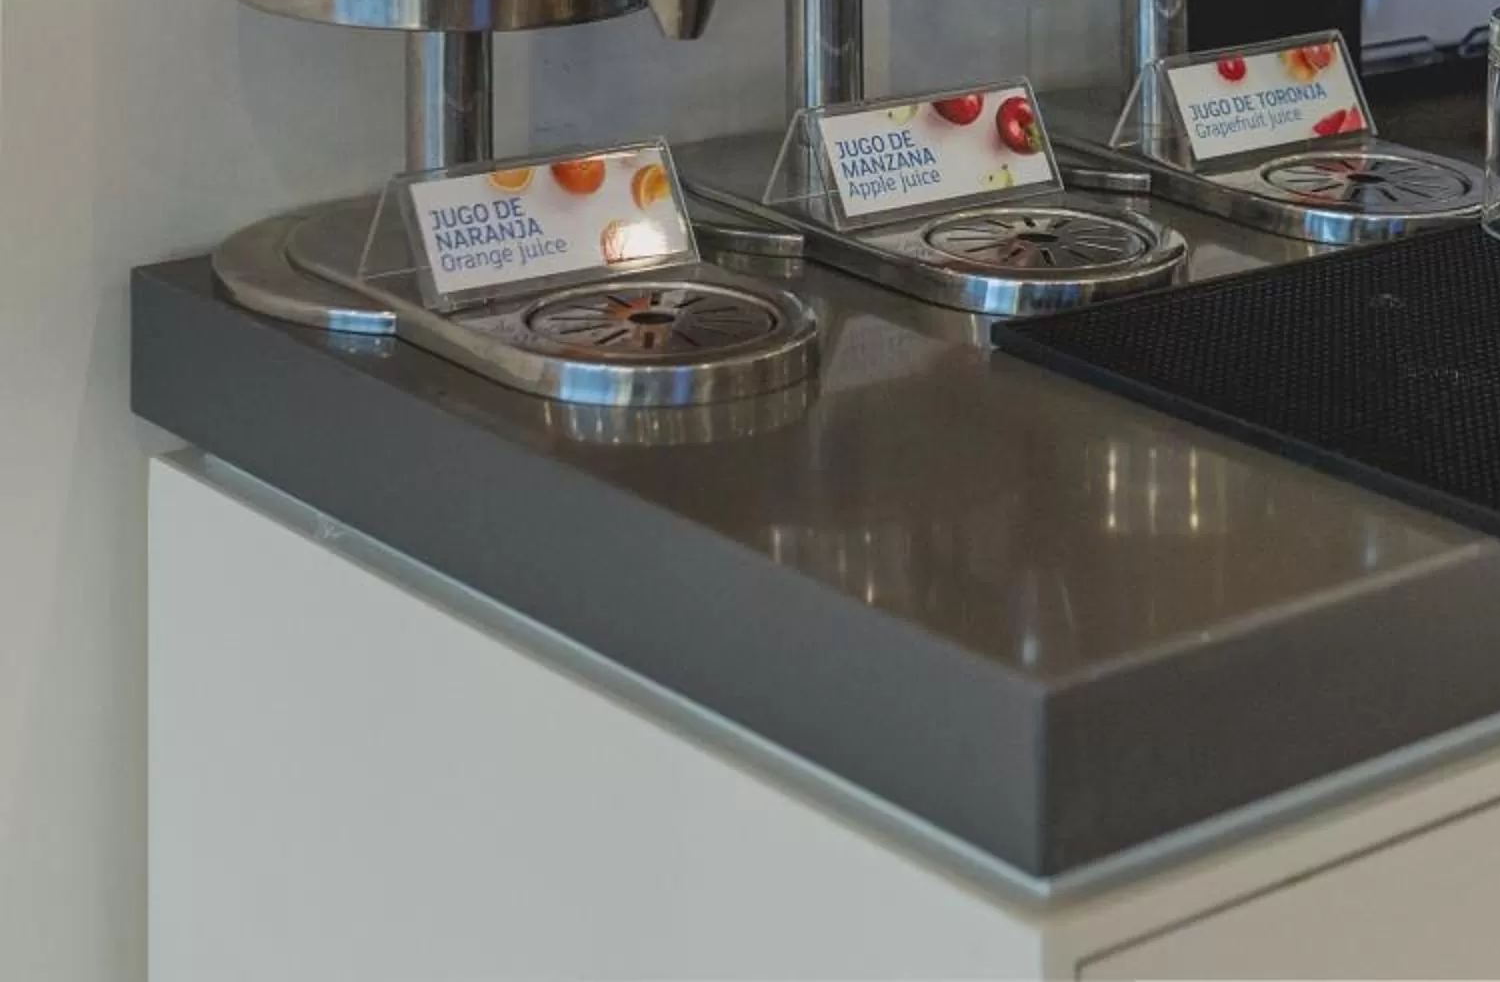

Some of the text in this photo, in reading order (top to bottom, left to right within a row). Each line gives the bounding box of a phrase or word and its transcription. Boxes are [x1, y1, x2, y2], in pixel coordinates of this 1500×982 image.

[1188, 81, 1327, 121] JUGO DE TORONJA
[1196, 111, 1269, 139] Grapefruit
[835, 129, 916, 160] JUGO DE
[841, 148, 937, 179] MANZANA
[848, 168, 940, 200] Apple juice
[429, 197, 526, 230] JUGO DE
[436, 218, 543, 251] NARANJA
[441, 237, 569, 273] Orange juice
